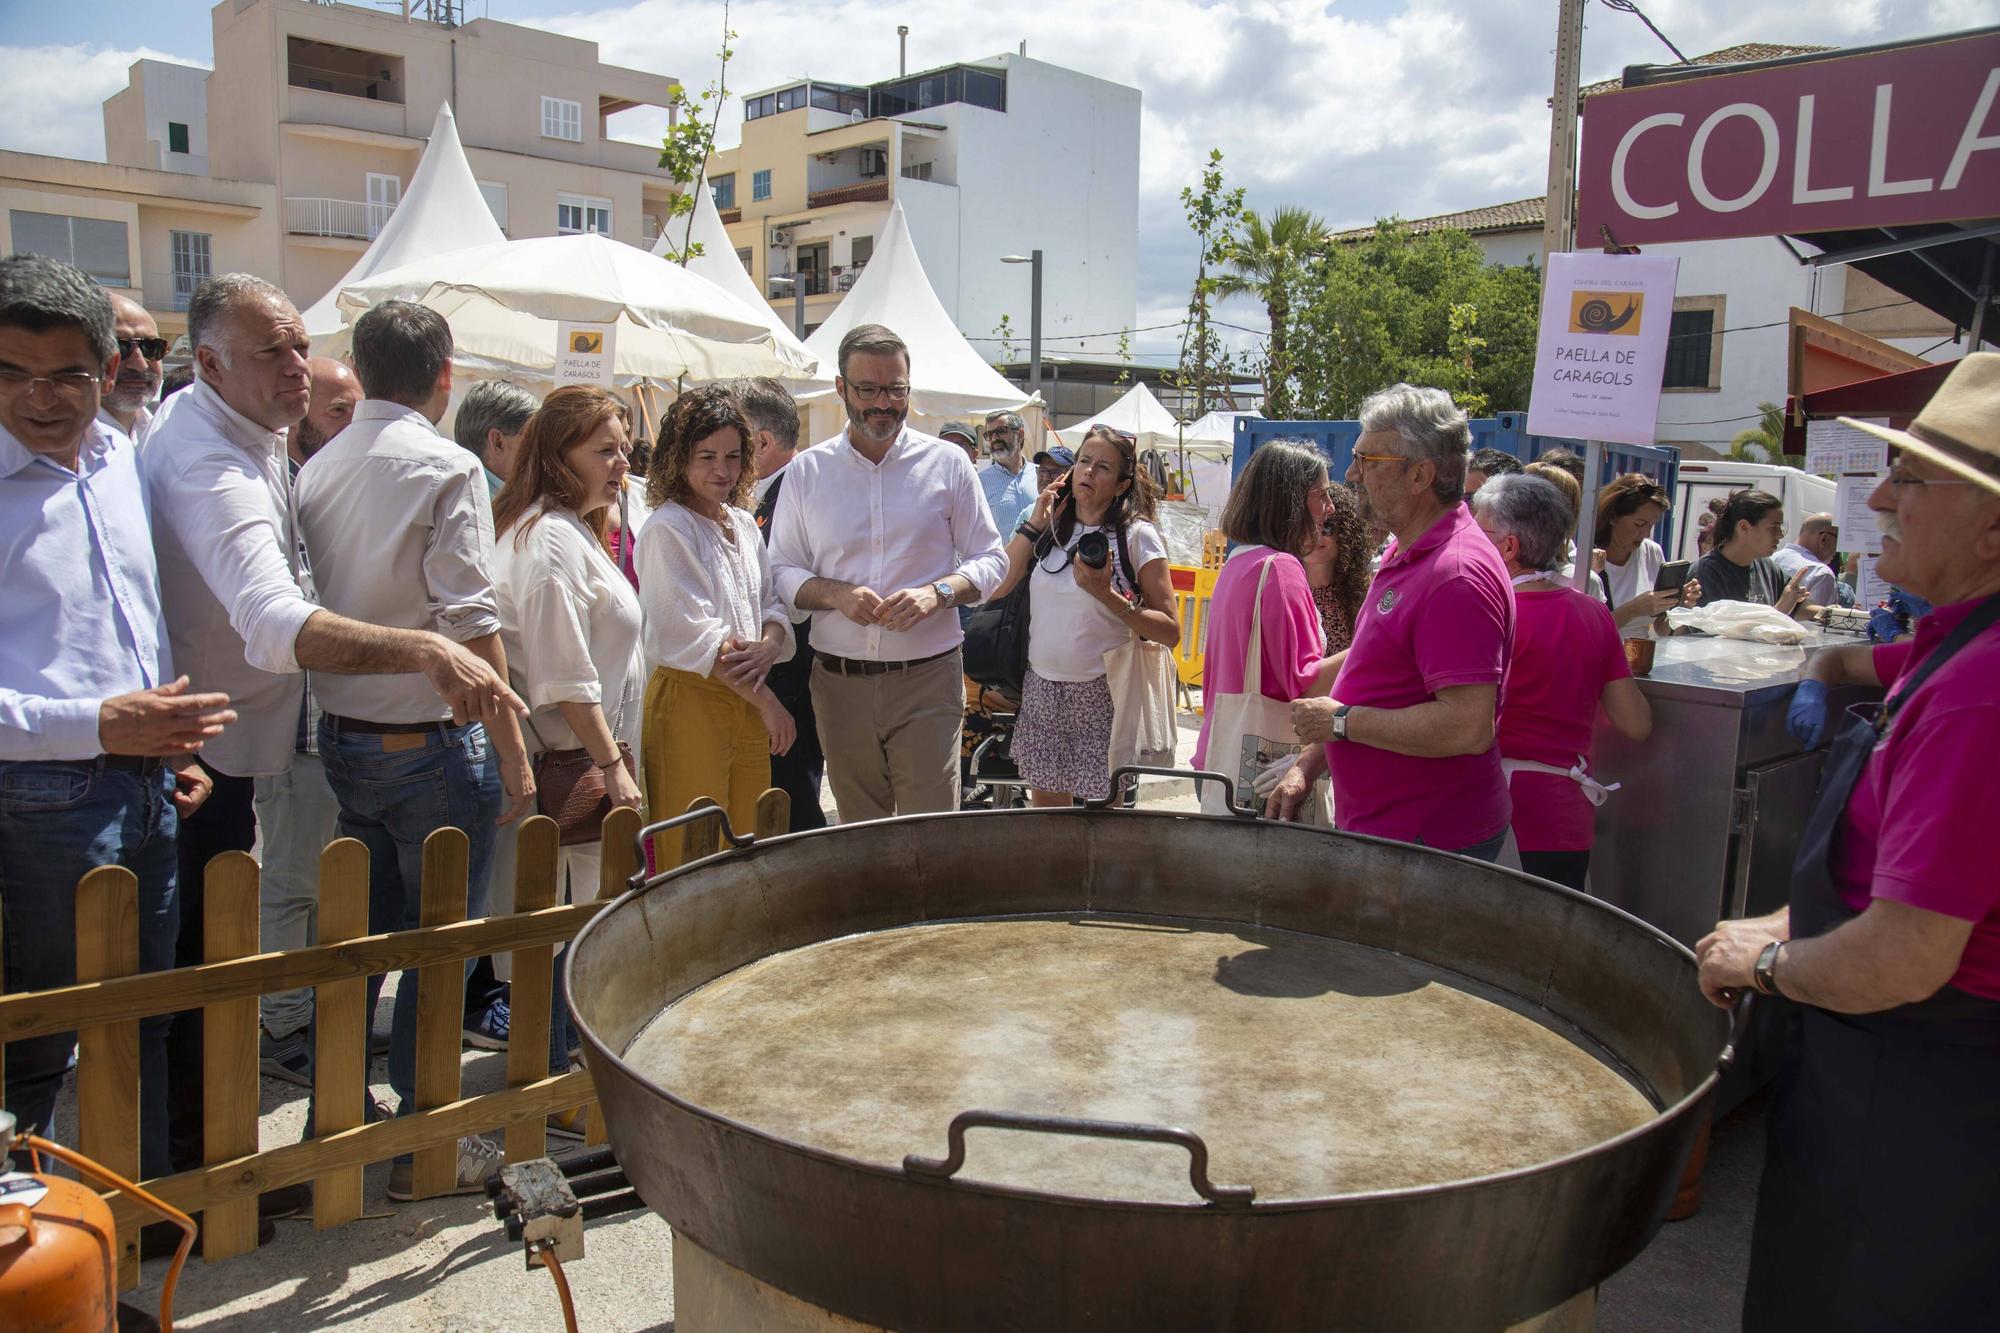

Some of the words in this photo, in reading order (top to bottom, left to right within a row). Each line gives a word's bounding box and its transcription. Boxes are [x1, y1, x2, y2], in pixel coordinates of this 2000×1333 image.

[1610, 67, 2000, 220] COLLA
[563, 359, 590, 368] PAELLA
[591, 360, 601, 369] DE
[1555, 347, 1610, 363] PAELLA
[1615, 350, 1636, 365] DE
[563, 370, 601, 379] CARAGOLS
[1553, 368, 1634, 386] CARAGOLS
